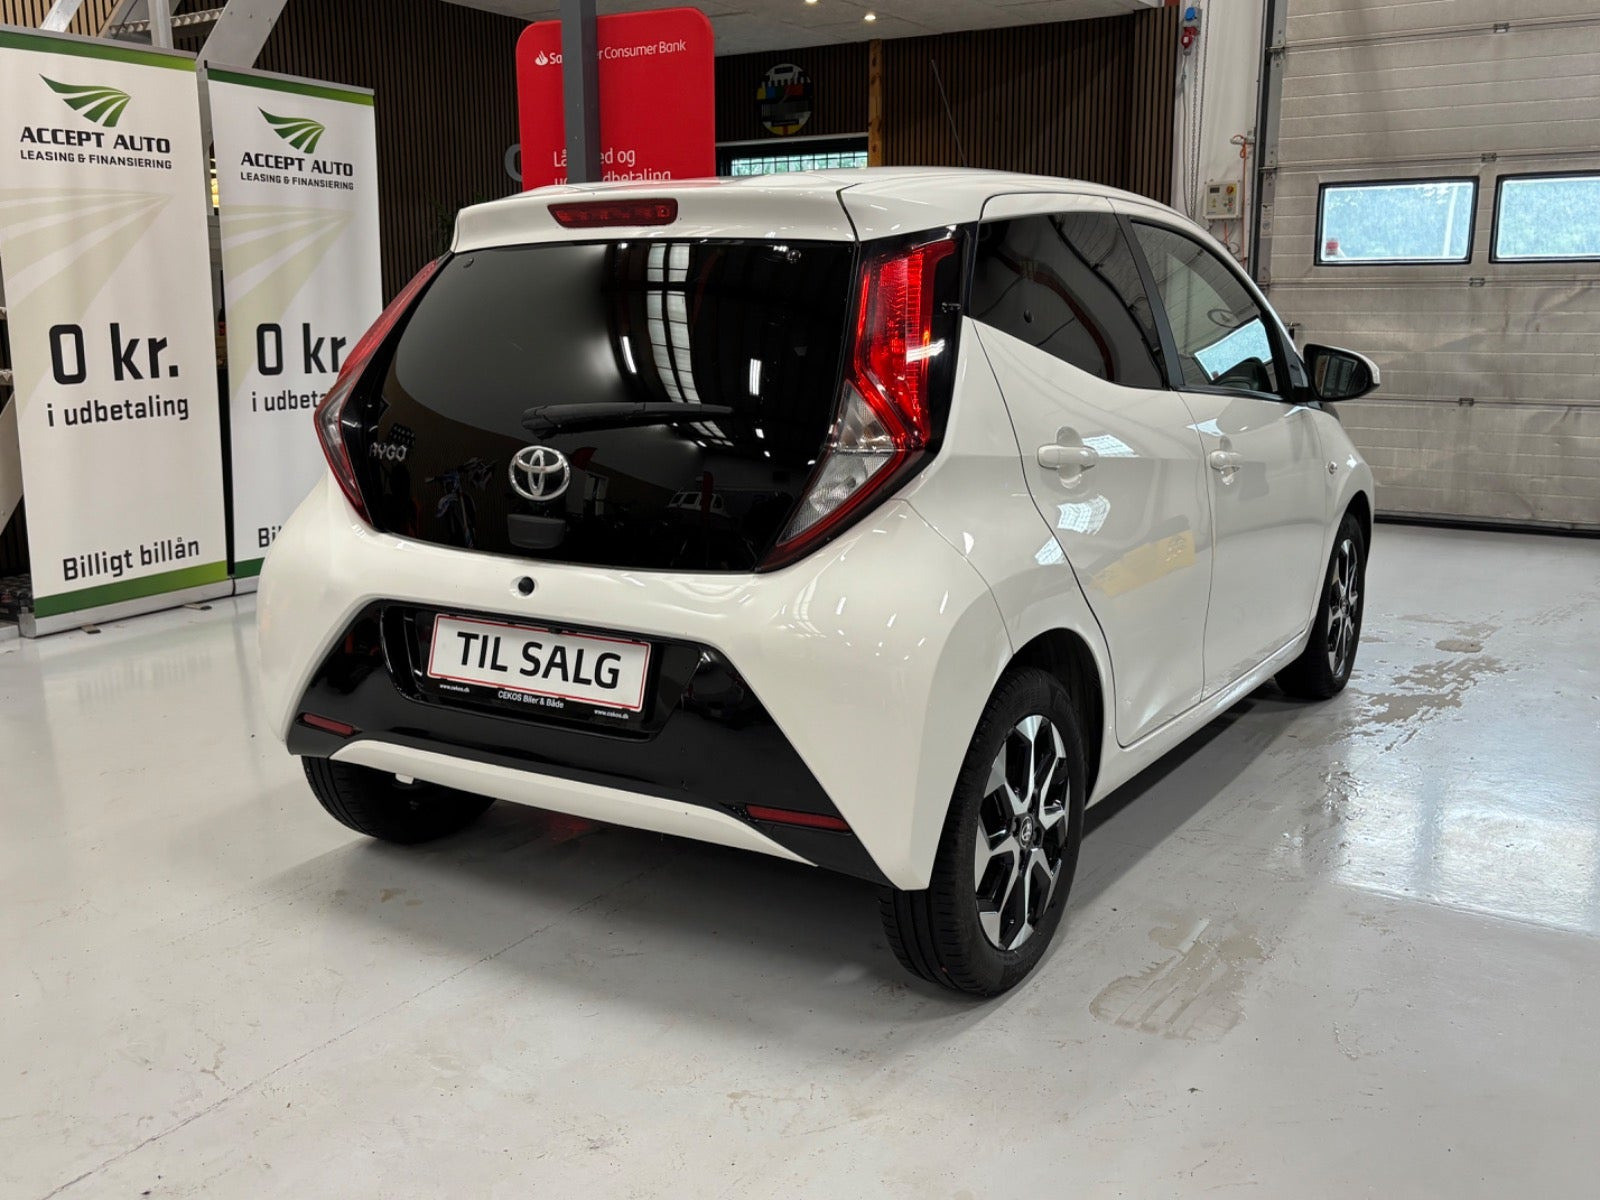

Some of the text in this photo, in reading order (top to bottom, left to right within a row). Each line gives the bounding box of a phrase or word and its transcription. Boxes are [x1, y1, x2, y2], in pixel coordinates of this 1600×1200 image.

[604, 43, 657, 59] Consumer
[659, 39, 687, 54] Bank
[20, 126, 171, 154] ACCEPT AUTO
[20, 150, 172, 170] LEASING & FINANSIERING
[241, 151, 353, 177] ACCEPT AUTO
[554, 148, 568, 167] Lå
[617, 150, 635, 168] og
[240, 171, 354, 191] LEASING & FINANSIERING
[602, 168, 671, 182] dbetaling
[49, 323, 180, 385] 0 kr.
[256, 323, 347, 376] 0 kr
[47, 395, 189, 427] i udbetaling
[251, 390, 327, 412] i udbet
[369, 441, 408, 462] AYGO
[62, 537, 200, 581] Billigt billån
[457, 631, 622, 690] TIL SALG
[497, 690, 522, 702] CEKOS
[522, 694, 539, 705] Biler
[546, 698, 565, 709] Både
